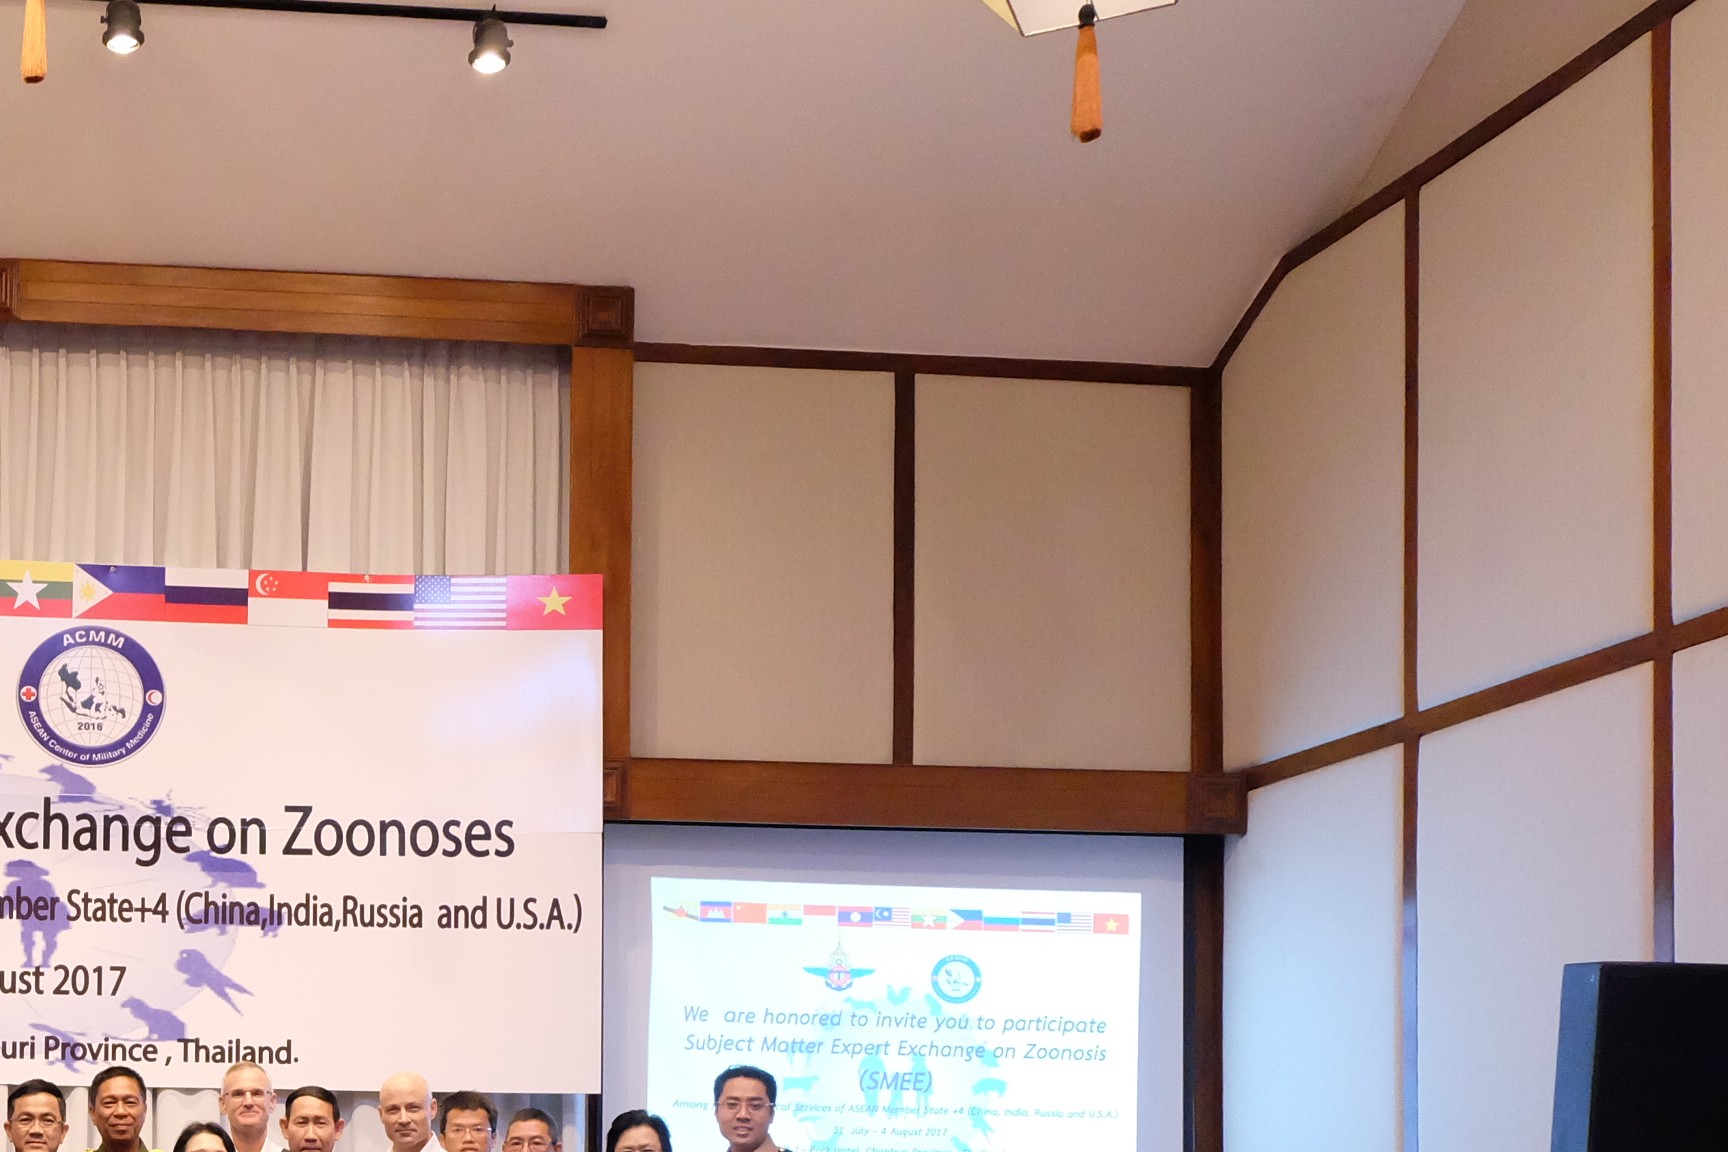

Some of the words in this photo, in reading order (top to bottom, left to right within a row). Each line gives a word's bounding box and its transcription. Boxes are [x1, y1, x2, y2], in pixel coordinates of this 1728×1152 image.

[63, 630, 125, 648] ACMM
[28, 710, 50, 741] ASEAN
[48, 739, 78, 759] Center
[79, 753, 90, 761] of
[92, 746, 126, 761] Military
[126, 713, 154, 749] Medicine
[77, 721, 103, 731] 2016
[207, 815, 267, 855] on
[282, 805, 515, 858] Zoonoses
[67, 888, 169, 924] State+4
[177, 889, 423, 932] (China,India,Russia
[437, 896, 487, 930] and
[496, 894, 583, 933] U.S.A.)
[53, 965, 127, 996] 2017
[683, 1005, 709, 1022] We
[723, 1009, 756, 1024] are
[763, 1007, 842, 1026] honored
[850, 1010, 869, 1027] to
[876, 1011, 928, 1029] invite
[933, 1016, 969, 1033] you
[976, 1014, 995, 1030] to
[1002, 1016, 1107, 1036] participate
[44, 1035, 158, 1061] Province
[177, 1037, 300, 1065] Thailand.
[683, 1034, 755, 1054] Subject
[760, 1036, 824, 1054] Matter
[830, 1038, 890, 1058] Expert
[897, 1040, 986, 1062] Exchange
[993, 1045, 1016, 1059] on
[1023, 1043, 1107, 1061] Zoonosis
[859, 1070, 933, 1094] (SMEE)
[672, 1099, 708, 1111] Among
[793, 1103, 832, 1113] Services
[834, 1104, 846, 1113] of
[848, 1104, 879, 1114] ASEAN
[923, 1106, 951, 1116] State
[1034, 1109, 1064, 1118] Russia
[1067, 1109, 1085, 1119] and
[850, 1126, 871, 1137] July
[880, 1127, 887, 1135] 4
[889, 1127, 922, 1138] August
[925, 1128, 949, 1137] 2017
